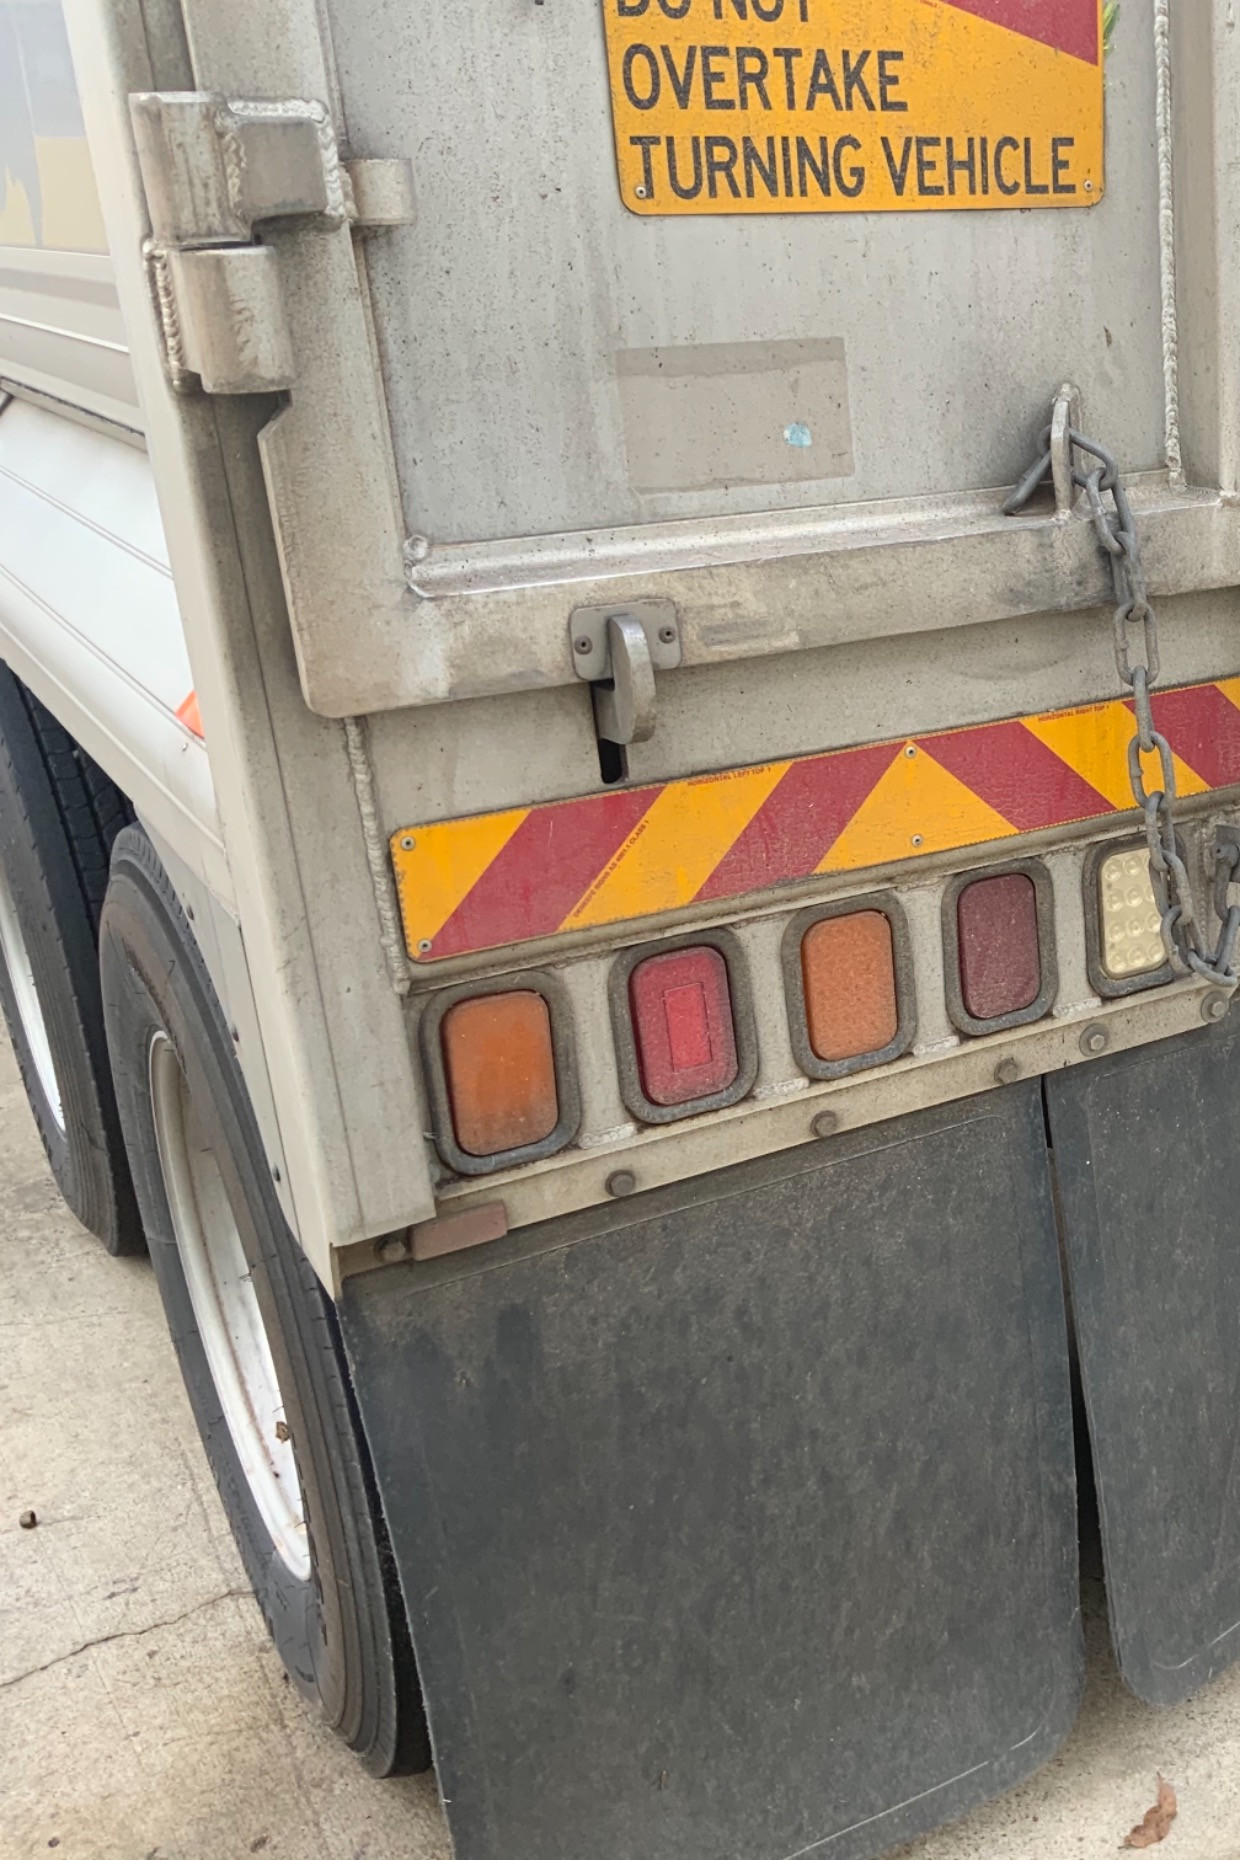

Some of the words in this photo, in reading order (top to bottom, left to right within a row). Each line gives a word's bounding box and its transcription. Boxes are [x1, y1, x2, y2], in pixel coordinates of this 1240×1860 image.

[622, 44, 908, 112] OVERTAKE
[629, 134, 866, 199] TURNING
[881, 136, 1076, 196] VEHICLE
[687, 775, 731, 787] HORIZONTAL
